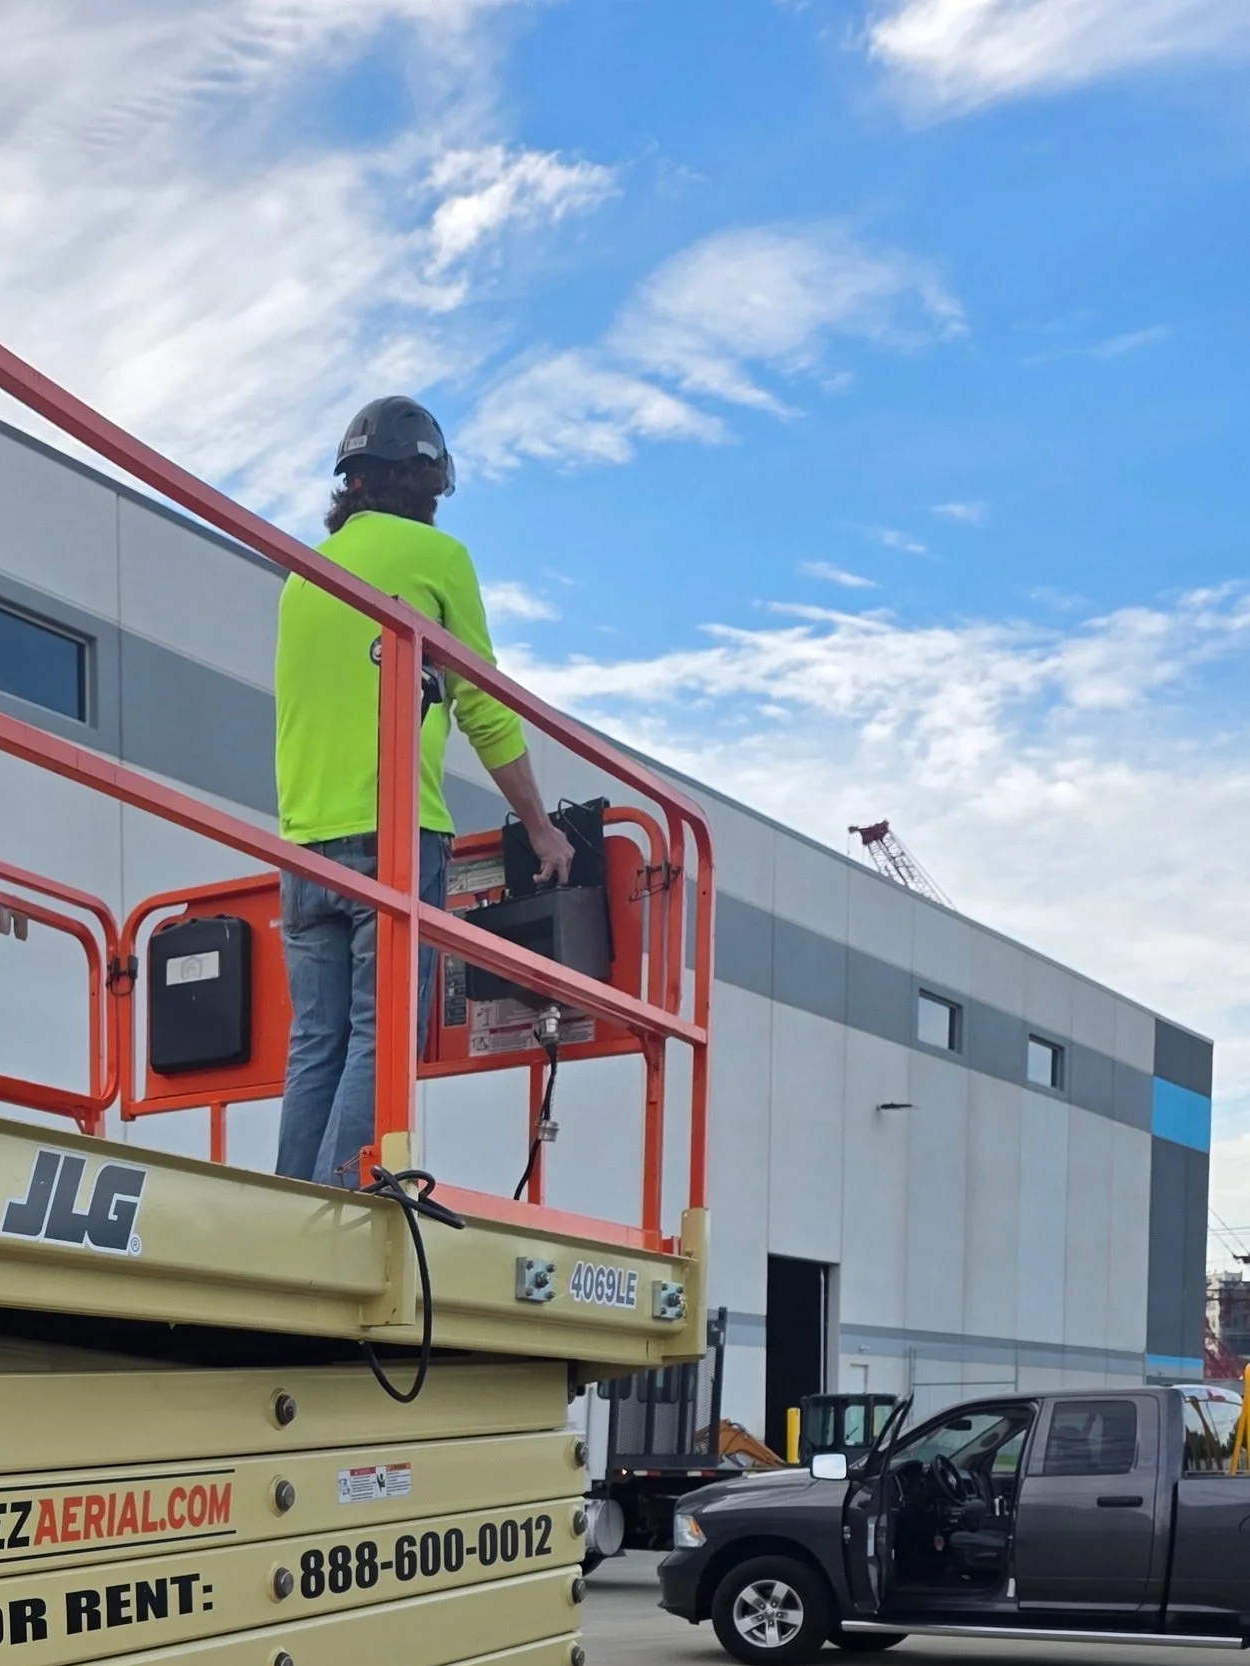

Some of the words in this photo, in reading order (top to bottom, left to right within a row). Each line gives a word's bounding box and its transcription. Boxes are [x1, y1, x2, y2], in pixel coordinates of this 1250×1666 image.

[1, 1150, 147, 1251] JLG
[571, 1263, 637, 1305] 4069LE
[300, 1514, 552, 1599] 888-600-0012
[65, 1573, 214, 1635] RENT:
